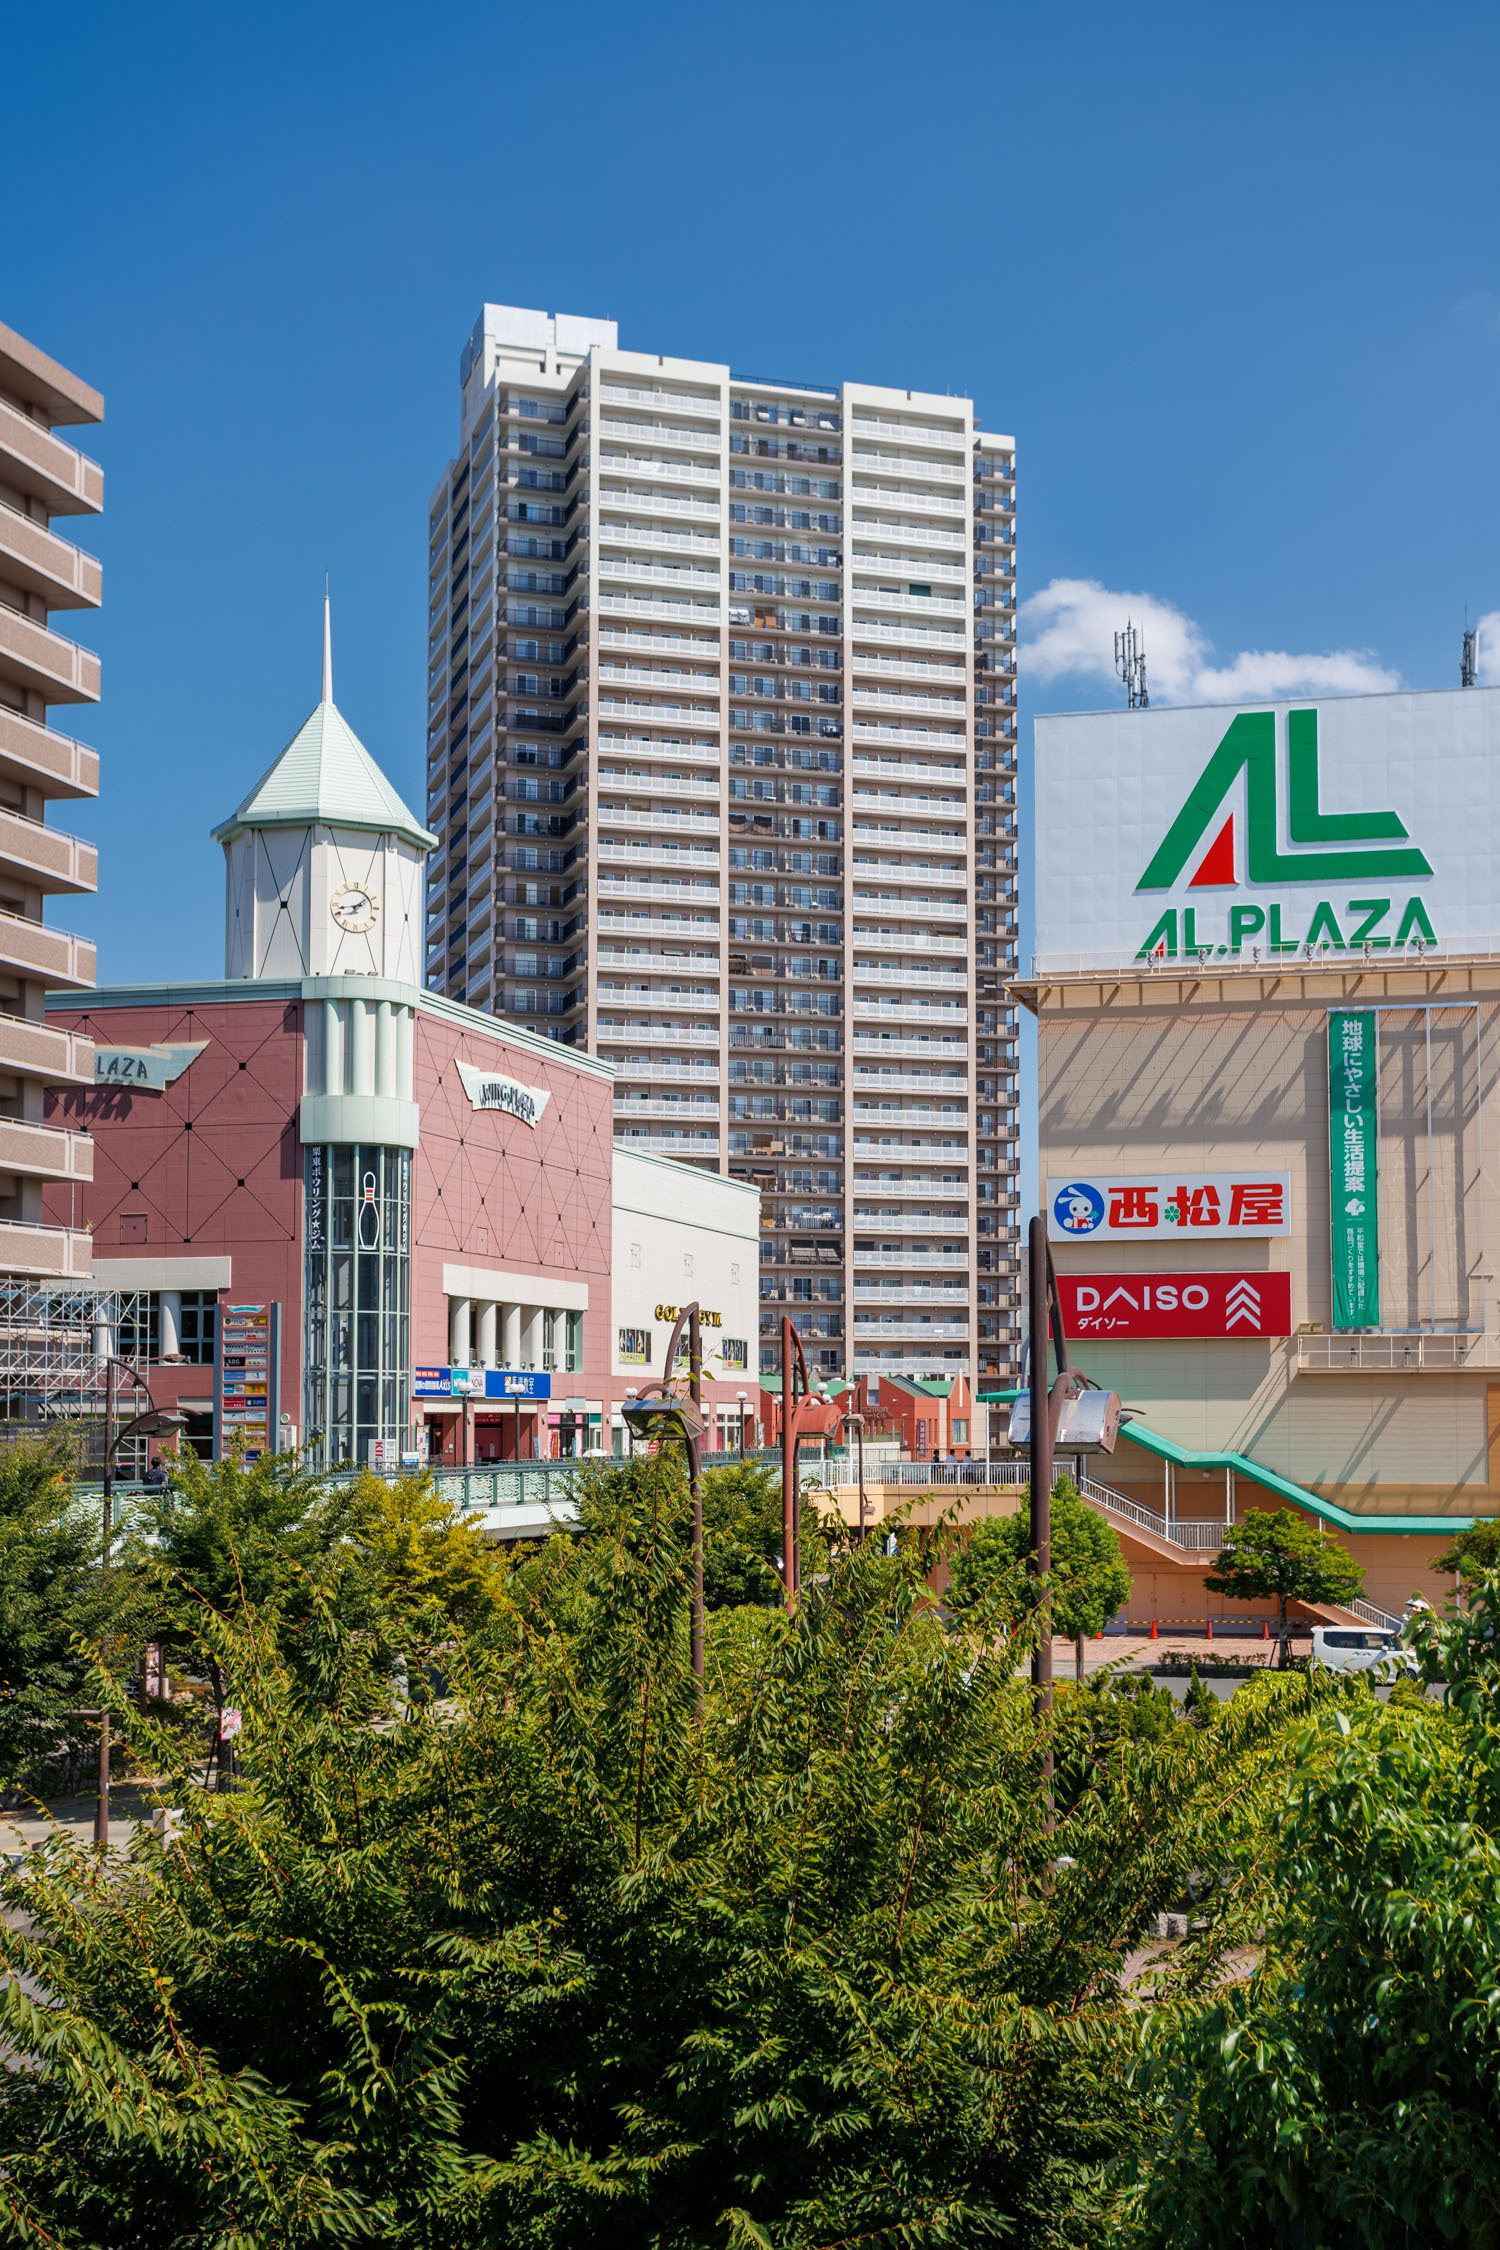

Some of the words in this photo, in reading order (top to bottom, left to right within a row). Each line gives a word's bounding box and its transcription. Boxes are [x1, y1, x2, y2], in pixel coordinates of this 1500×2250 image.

[97, 1056, 147, 1079] LAZA
[1342, 1019, 1365, 1193] 地球にやさしい生活提案
[1108, 1183, 1284, 1228] 西松屋
[1077, 1285, 1209, 1312] DAISO
[1077, 1316, 1130, 1330] ダイソー
